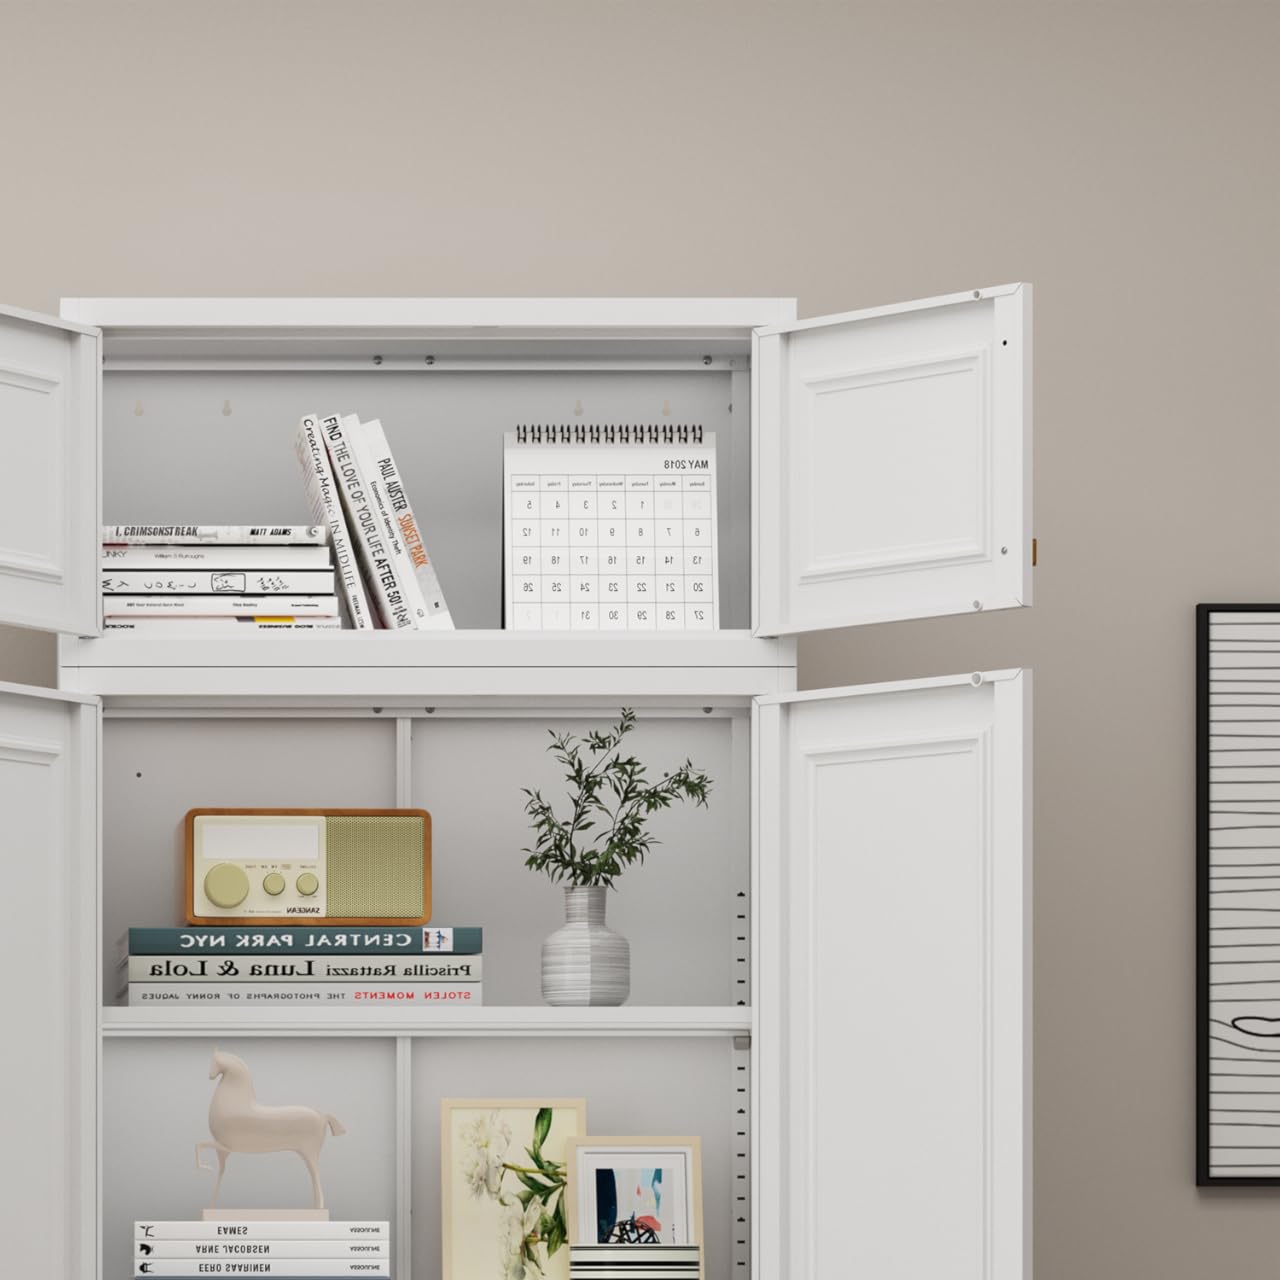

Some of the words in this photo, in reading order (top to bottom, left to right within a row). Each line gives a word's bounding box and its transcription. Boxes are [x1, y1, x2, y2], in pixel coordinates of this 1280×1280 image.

[323, 416, 342, 441] FIND
[304, 418, 324, 475] Creating
[334, 440, 350, 463] THE
[340, 462, 361, 490] LOVE
[377, 457, 396, 482] PAUL
[351, 489, 366, 505] OF
[385, 479, 408, 513] AUSTER
[356, 503, 377, 538] YOUR
[370, 481, 385, 512] Economics
[391, 539, 402, 555] Theft
[398, 511, 420, 545] SUNSET
[249, 528, 267, 536] MATT
[368, 534, 385, 559] LIFE
[411, 543, 429, 569] PARK
[374, 557, 398, 592] AFTER
